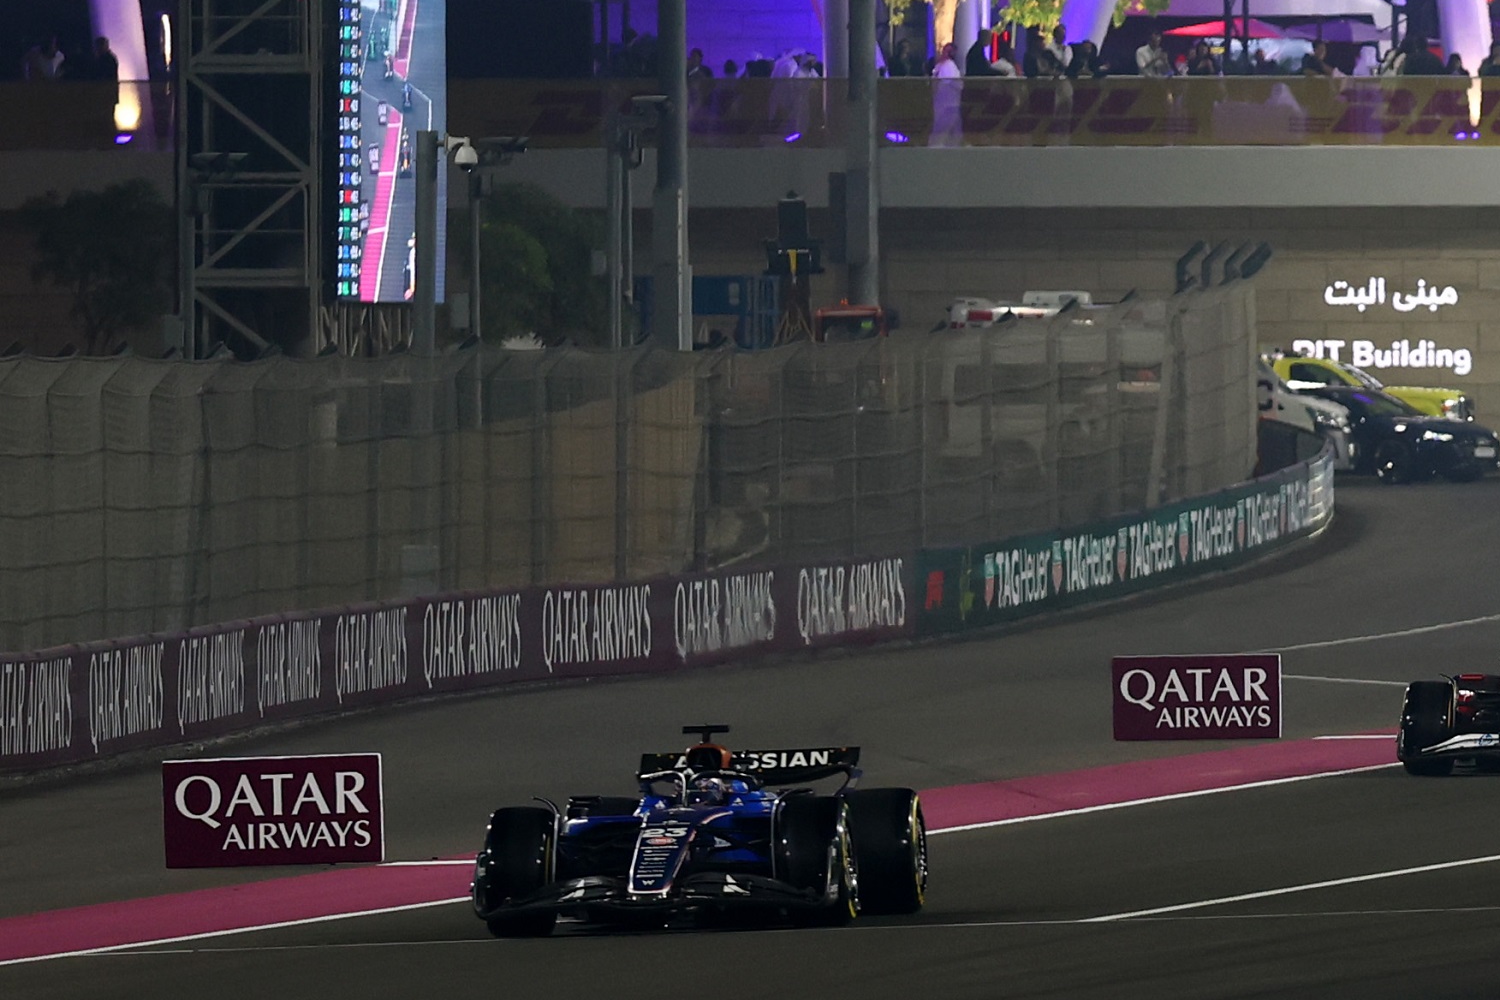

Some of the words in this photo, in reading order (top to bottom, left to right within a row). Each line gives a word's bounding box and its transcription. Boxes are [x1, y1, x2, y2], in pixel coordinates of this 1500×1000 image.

[1324, 277, 1386, 313] البت
[1393, 278, 1458, 312] مبنى
[1352, 339, 1472, 375] Building
[423, 601, 465, 689] QATAR
[468, 593, 521, 674] AIRWAYS
[543, 590, 589, 673] QATAR
[592, 585, 651, 661] AIRWAYS
[675, 579, 721, 663] QATAR
[724, 570, 776, 647] AIRWAYS
[798, 566, 845, 645] QATAR
[849, 558, 905, 630] AIRWAYS
[90, 650, 122, 753] QATAR
[123, 641, 164, 735] AIRWAYS
[177, 636, 208, 735] QATAR
[209, 629, 244, 718] AIRWAYS
[257, 624, 286, 718] QATAR
[287, 618, 321, 702] AIRWAYS
[335, 614, 366, 704] QATAR
[367, 606, 407, 691] AIRWAYS
[1120, 667, 1270, 711] QATAR
[25, 657, 72, 753] AIRWAYS
[1156, 705, 1272, 729] AIRWAYS
[175, 771, 370, 829] QATAR
[222, 820, 371, 850] AIRWAYS
[642, 827, 688, 838] 23
